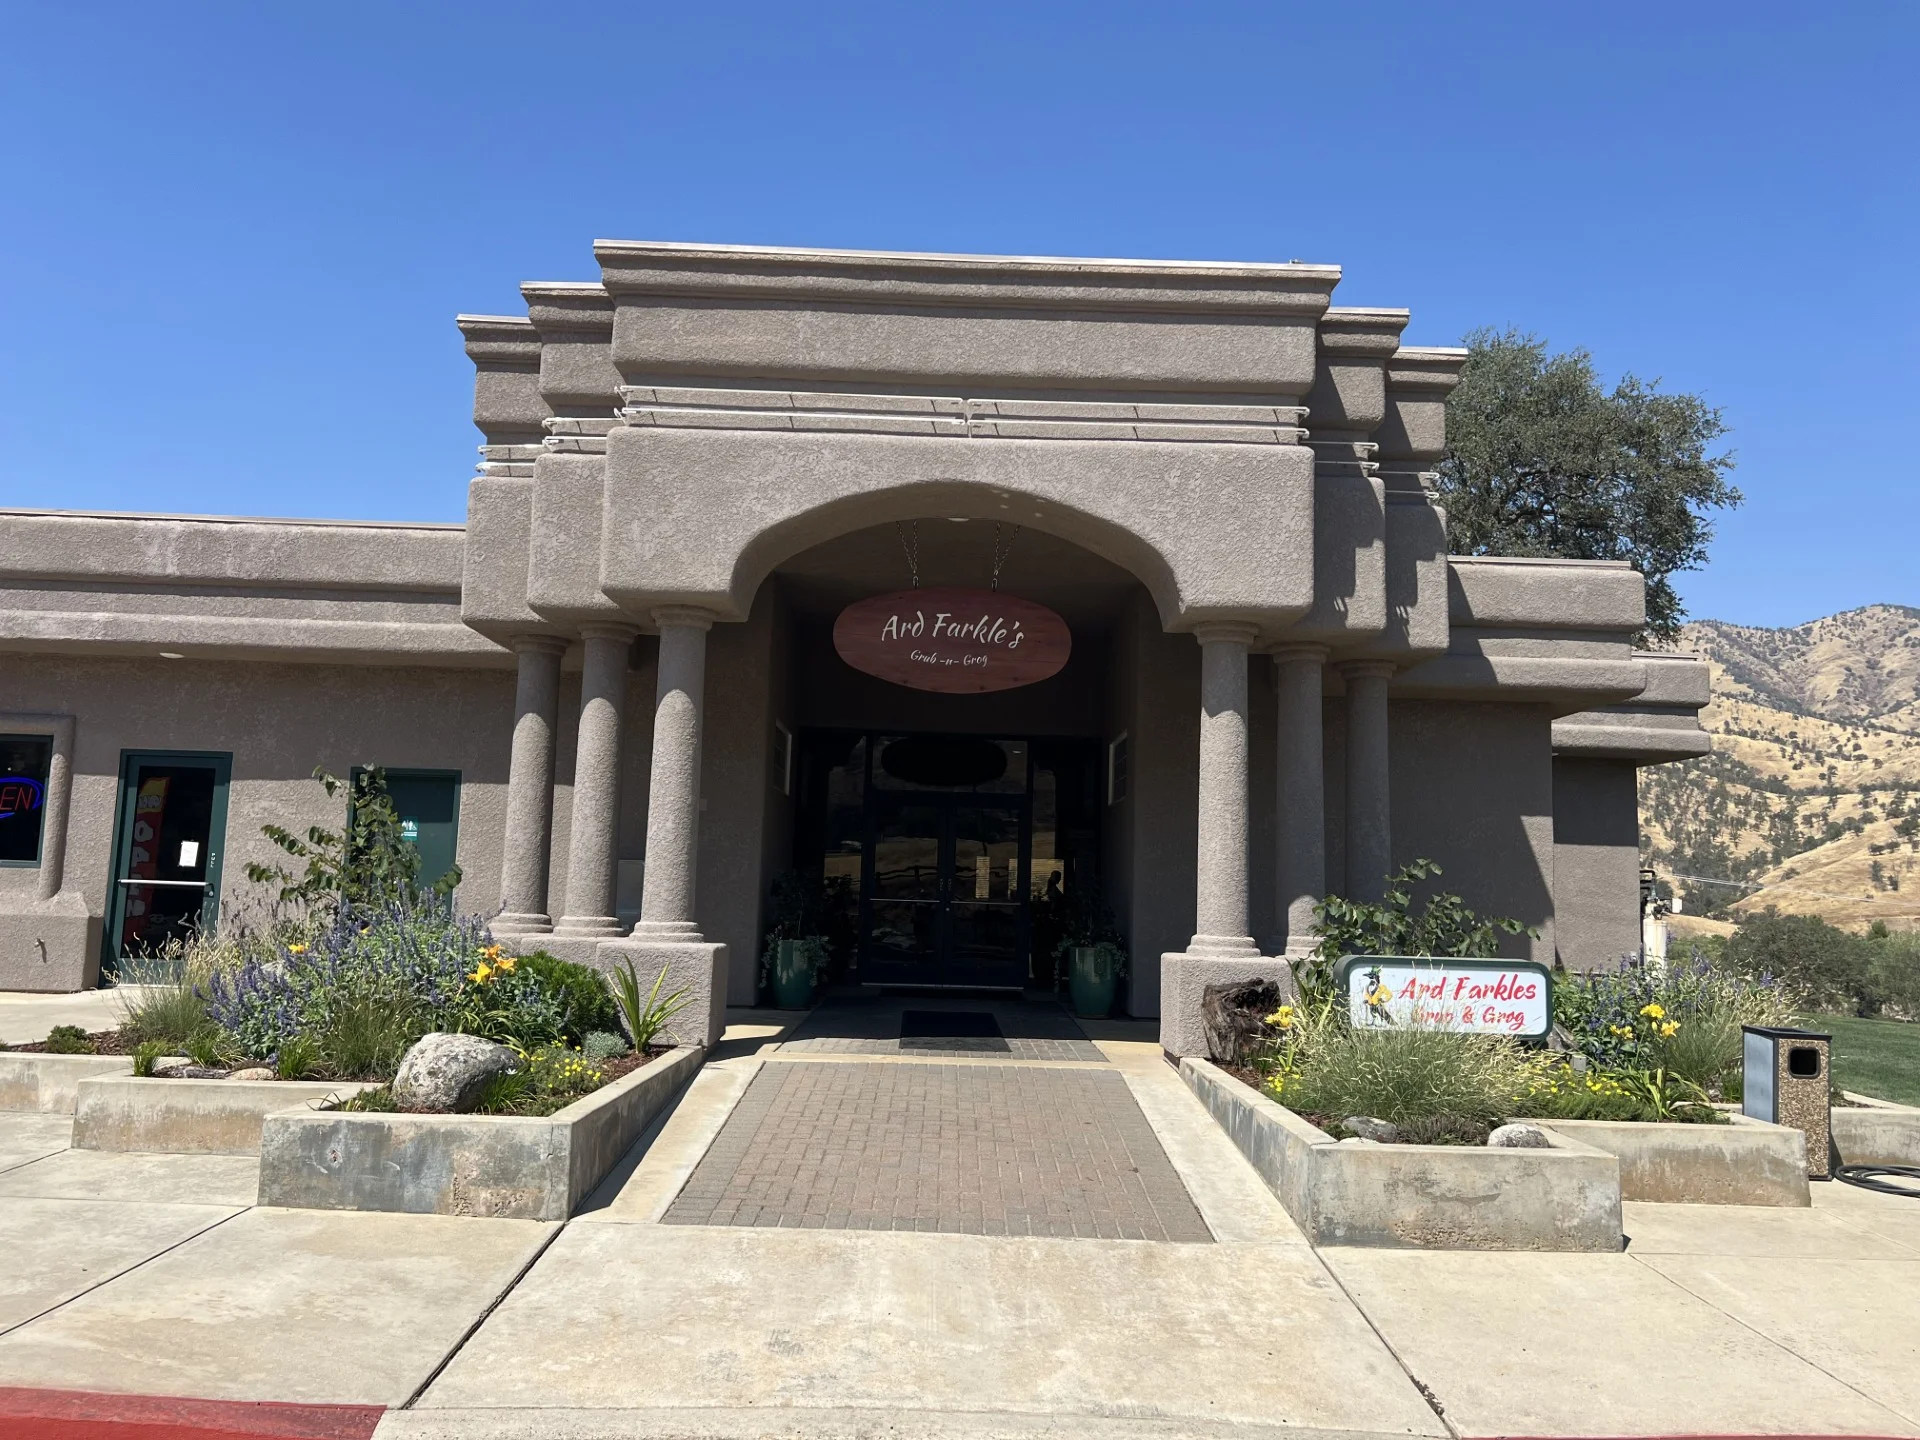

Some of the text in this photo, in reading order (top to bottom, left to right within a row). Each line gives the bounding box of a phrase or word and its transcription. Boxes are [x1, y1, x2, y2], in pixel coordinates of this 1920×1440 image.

[881, 610, 1025, 649] Ard Farkle's
[910, 649, 937, 665] Grub
[963, 654, 988, 668] Grog
[1398, 973, 1537, 1002] Ard Farkles
[1462, 1005, 1474, 1024] &
[1482, 1006, 1527, 1031] Grog
